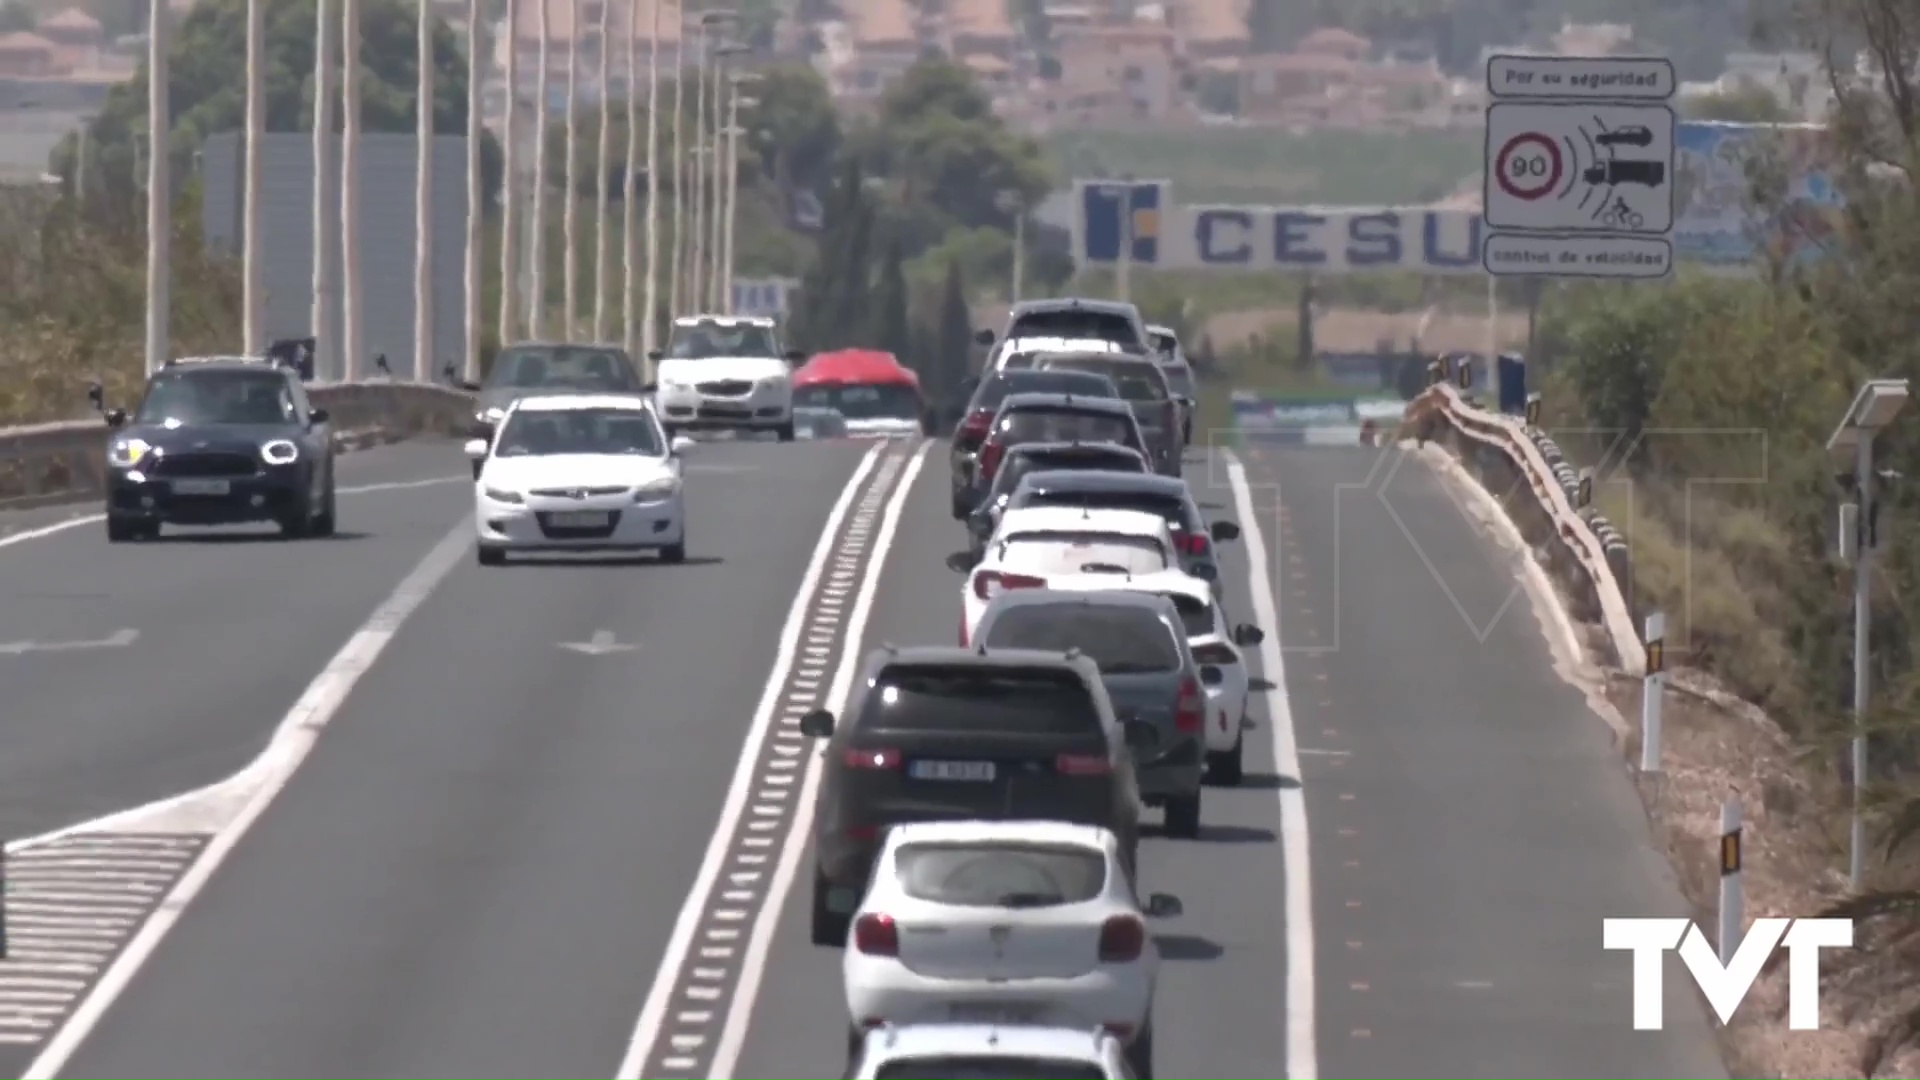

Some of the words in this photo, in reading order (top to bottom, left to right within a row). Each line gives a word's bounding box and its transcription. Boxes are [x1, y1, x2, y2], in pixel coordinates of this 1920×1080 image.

[1506, 68, 1534, 85] Por
[1542, 74, 1562, 85] su
[1570, 72, 1657, 89] seguridad
[1511, 155, 1546, 177] 90
[1558, 250, 1578, 264] de
[1585, 251, 1663, 265] velocidad
